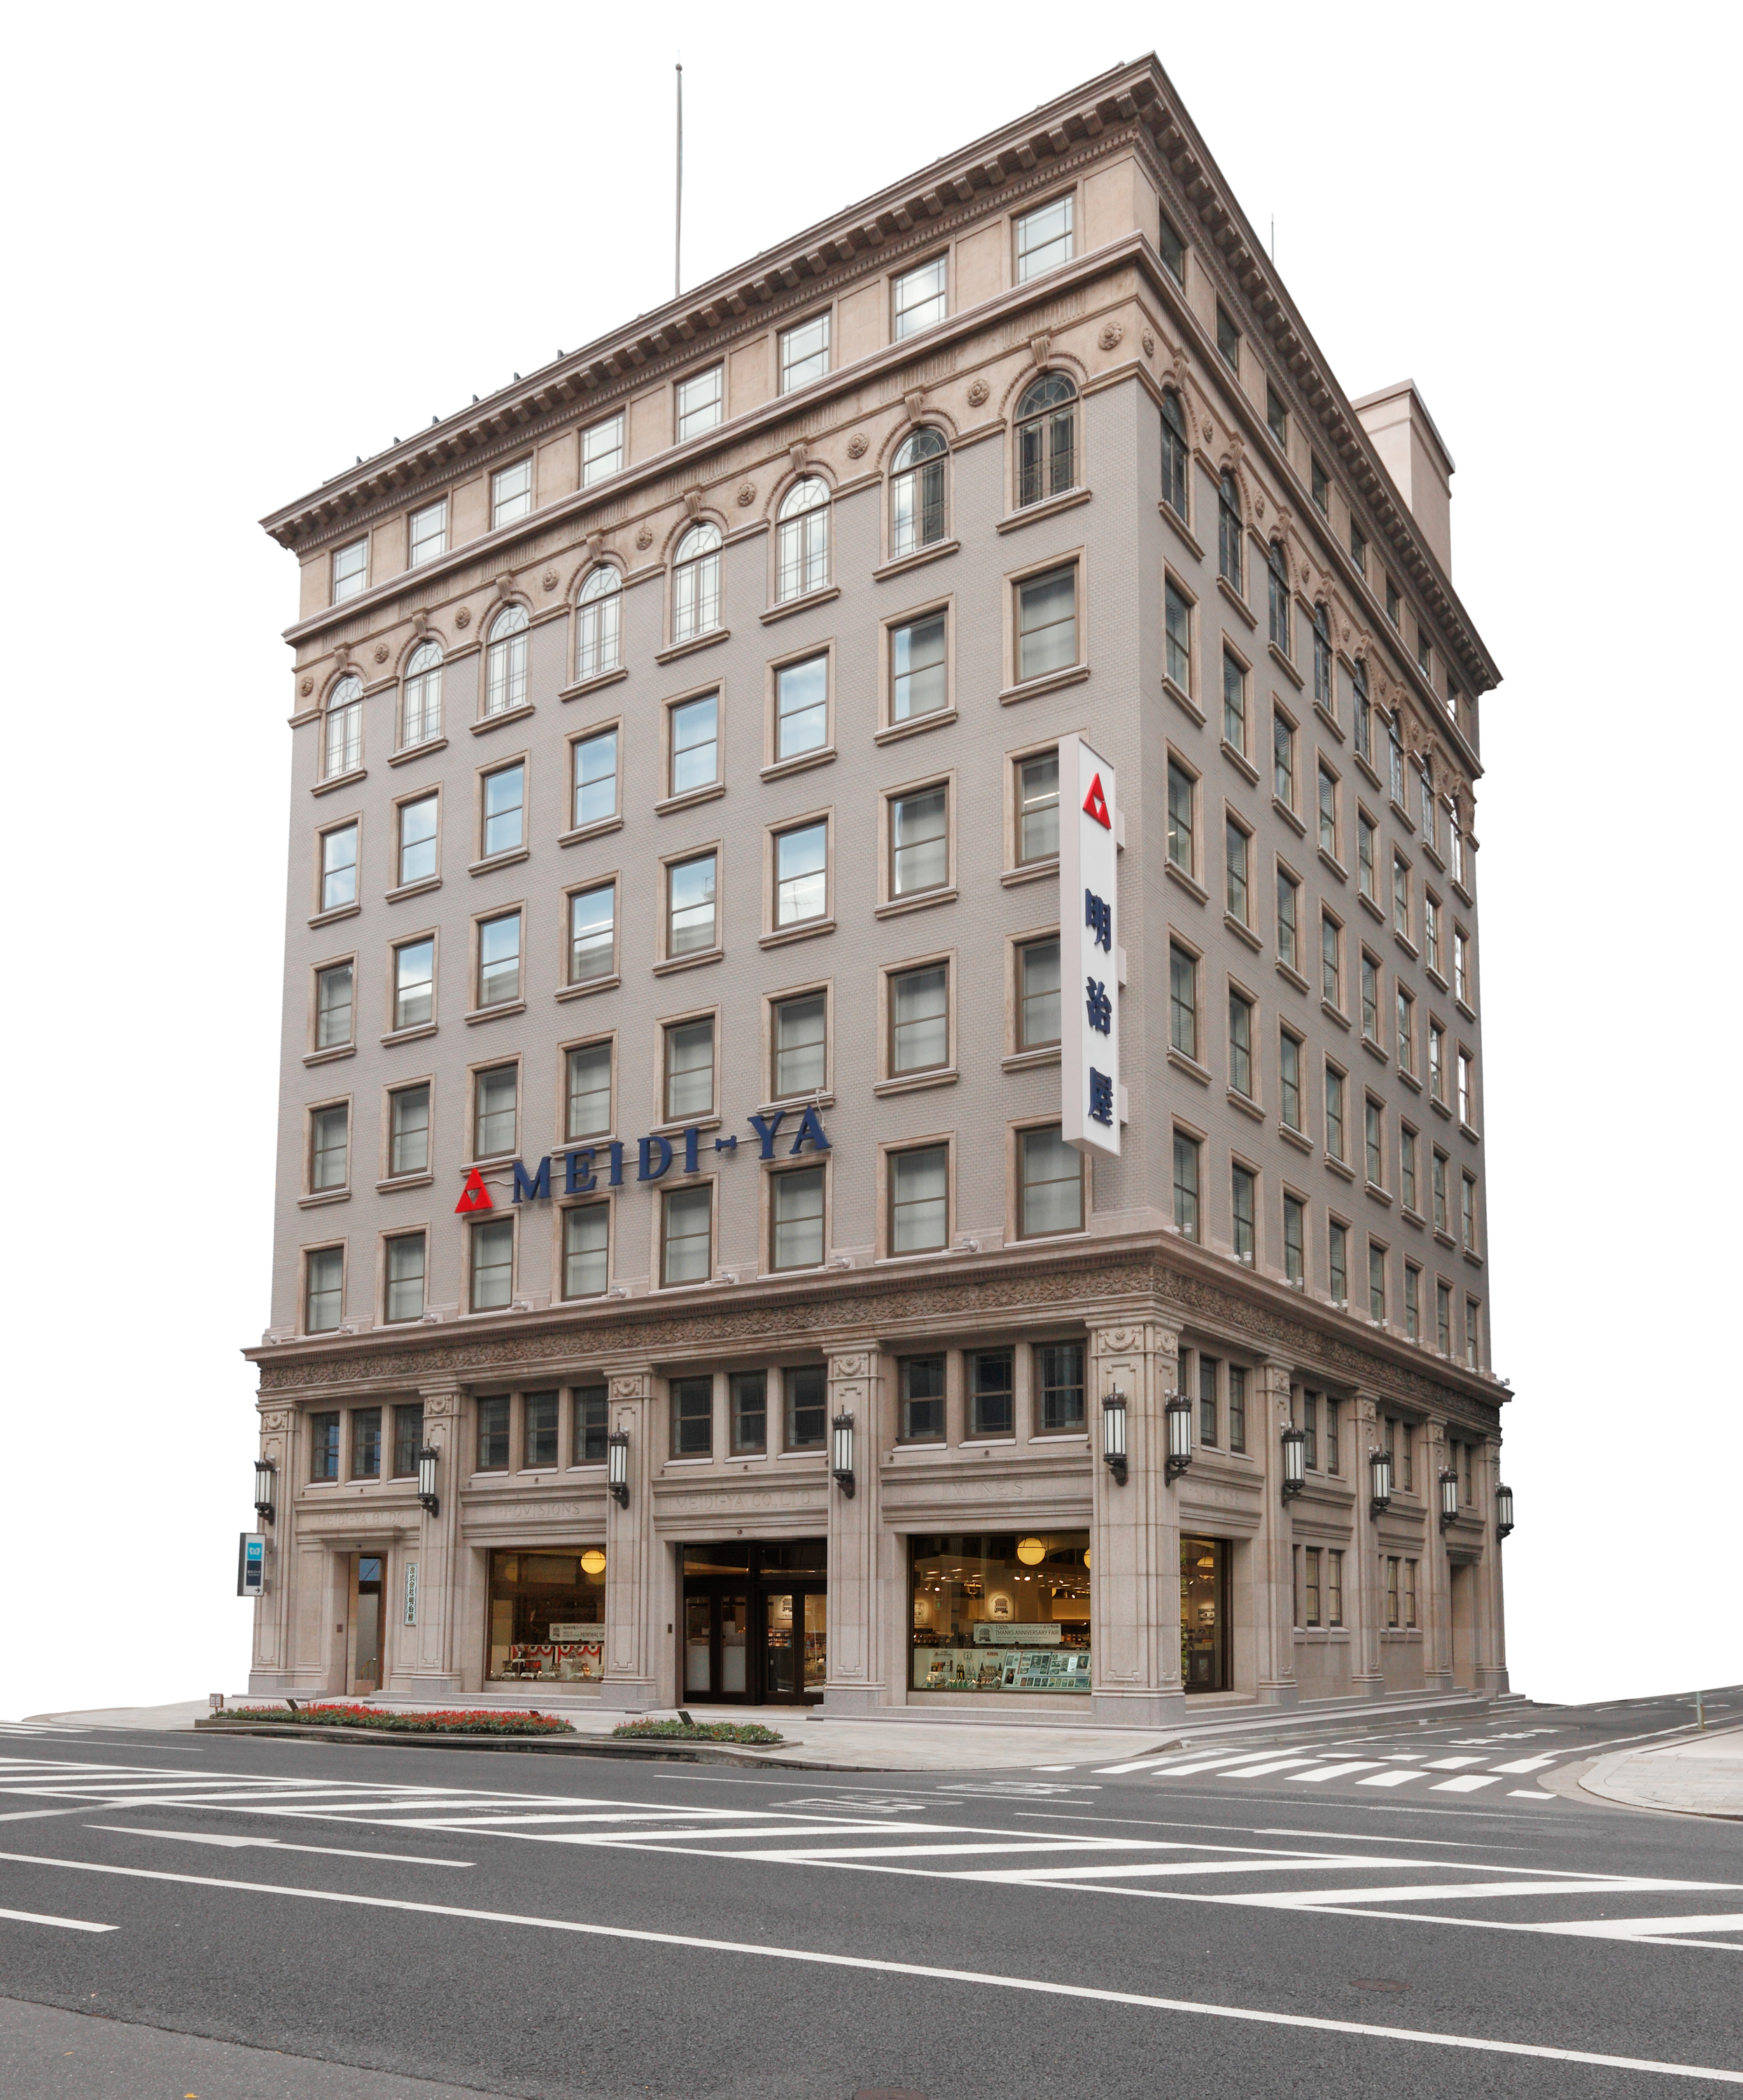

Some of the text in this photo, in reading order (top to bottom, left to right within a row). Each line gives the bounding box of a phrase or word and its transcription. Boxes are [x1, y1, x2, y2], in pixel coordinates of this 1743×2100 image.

[1084, 888, 1114, 1127] 明治屋
[511, 1105, 833, 1204] MEIDI-YA
[953, 1480, 1024, 1497] WINES
[496, 1502, 580, 1518] PROVISIONS
[675, 1493, 744, 1511] MEIDI-YA
[317, 1511, 407, 1527] MEIDI-YA BLDG.
